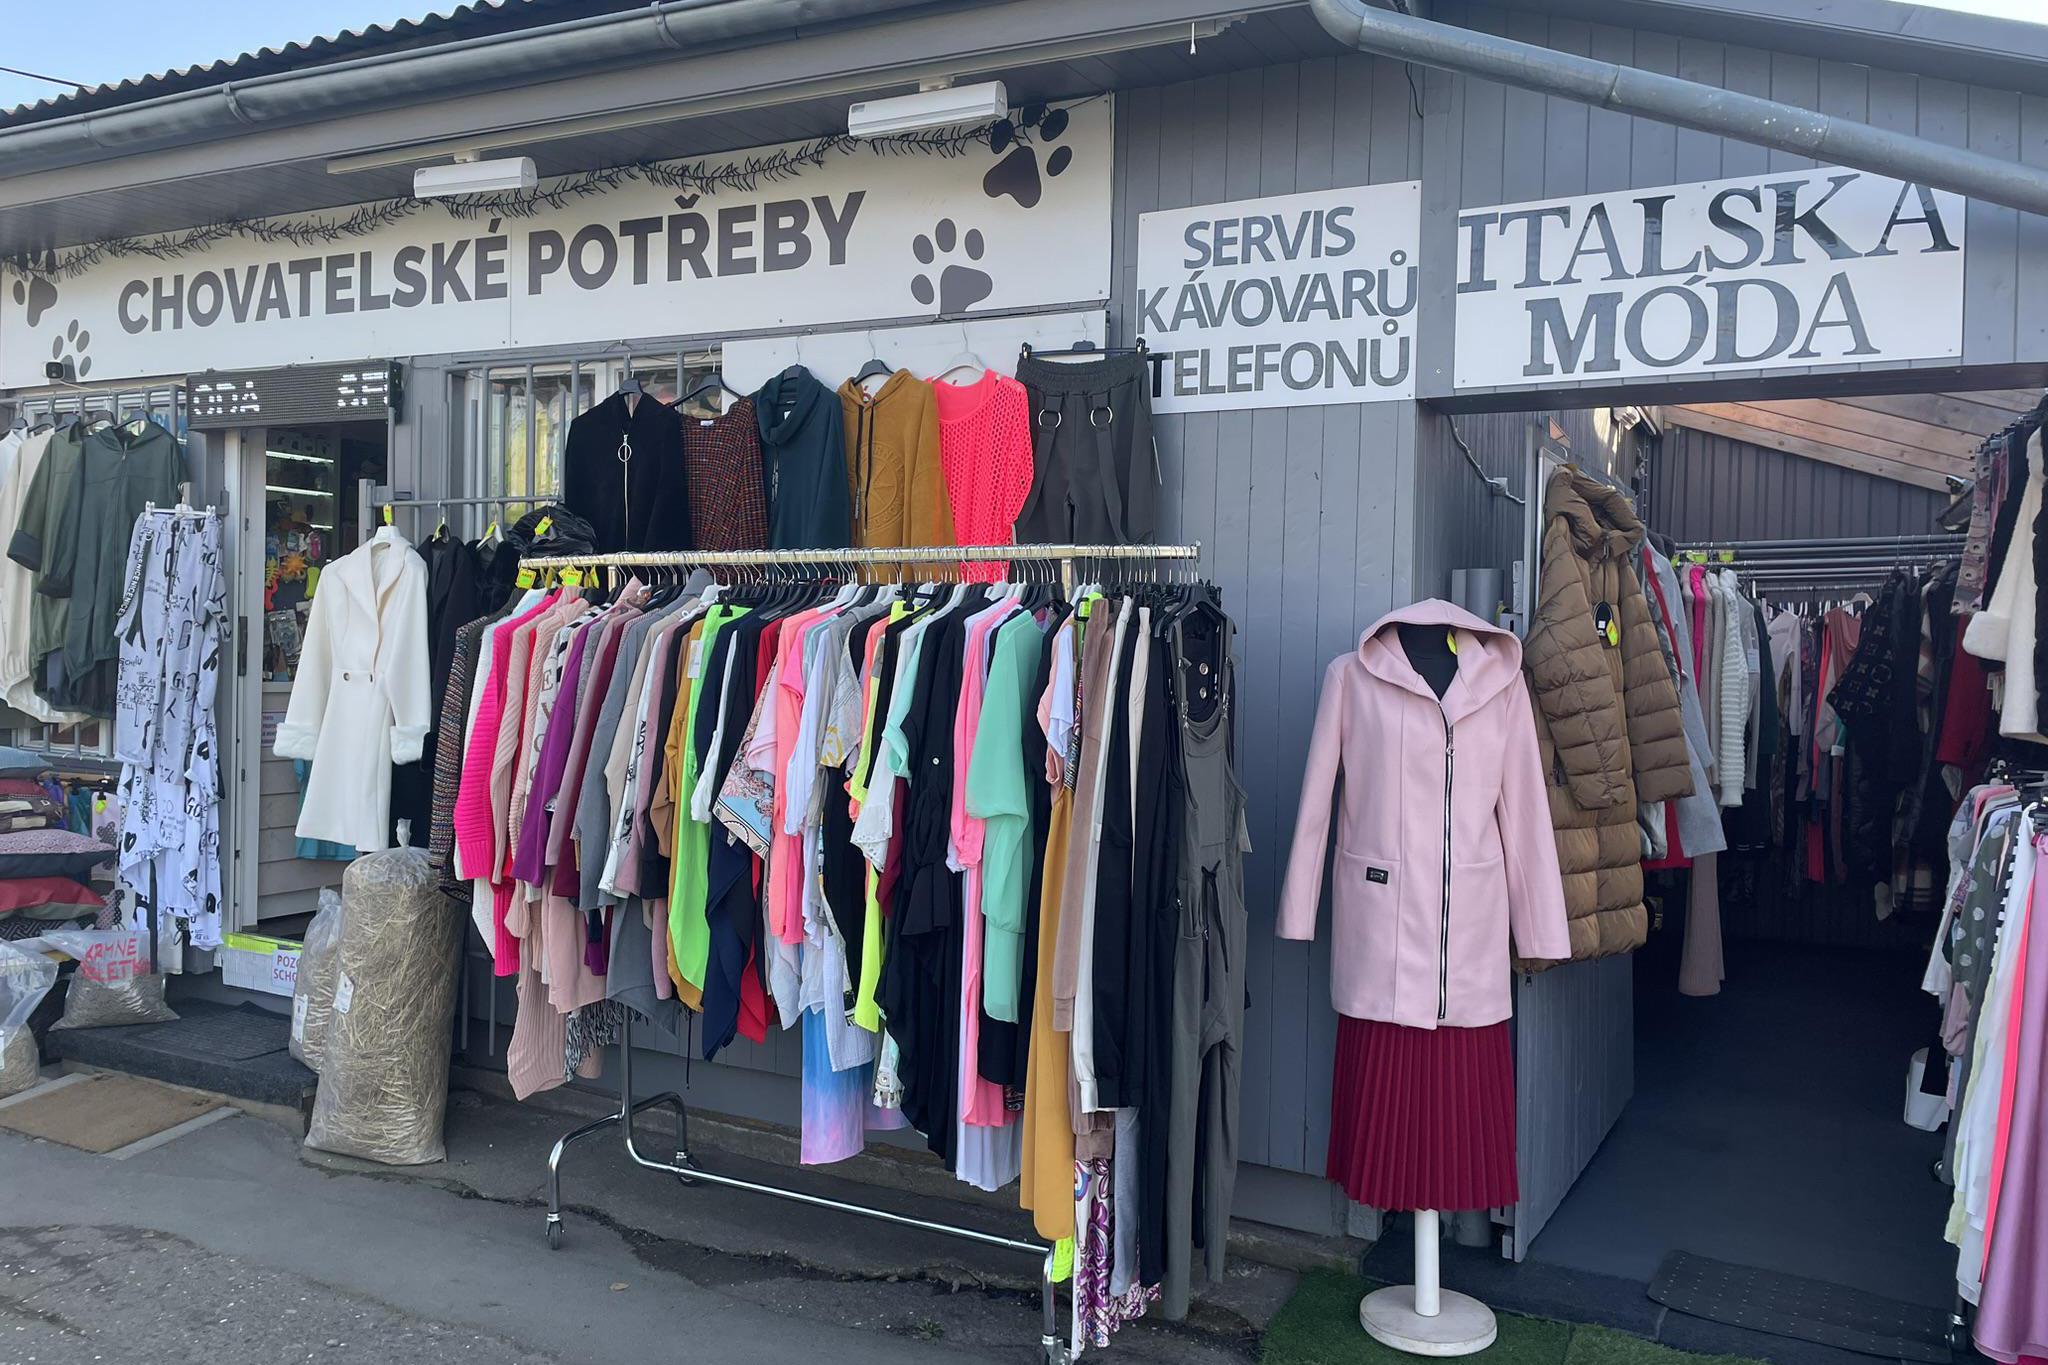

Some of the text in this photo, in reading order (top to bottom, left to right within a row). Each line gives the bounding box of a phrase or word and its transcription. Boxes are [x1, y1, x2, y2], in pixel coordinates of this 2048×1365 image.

[117, 190, 866, 334] CHOVATELSKÉ POTŘEBY
[1183, 206, 1356, 269] SERVIS
[1137, 249, 1418, 335] KÁVOVARŮ
[1523, 271, 1881, 377] MÓDA
[1147, 318, 1411, 398] TELEFONŮ
[276, 955, 299, 969] POZ
